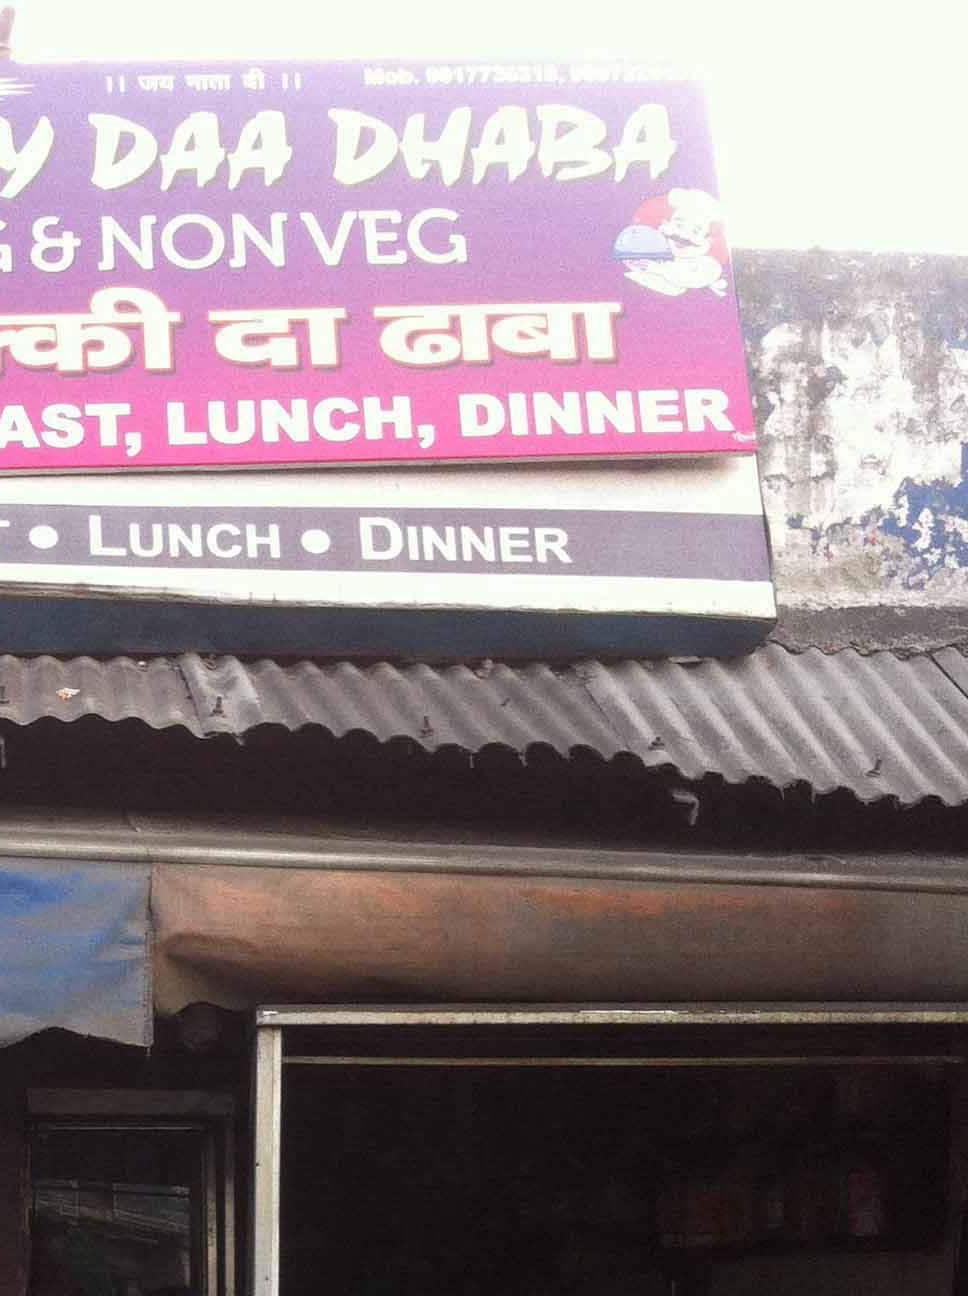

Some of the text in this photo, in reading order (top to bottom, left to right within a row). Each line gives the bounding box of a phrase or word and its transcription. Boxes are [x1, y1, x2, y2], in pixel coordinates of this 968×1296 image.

[89, 111, 292, 191] DAA
[328, 103, 678, 187] DHABA
[31, 215, 81, 273] &
[207, 305, 346, 370] दा
[372, 302, 622, 368] ढाबा
[167, 395, 436, 449] LUNCH,
[457, 387, 734, 438] DINNER
[88, 514, 281, 559] LUNCH
[358, 516, 573, 564] DINNER
